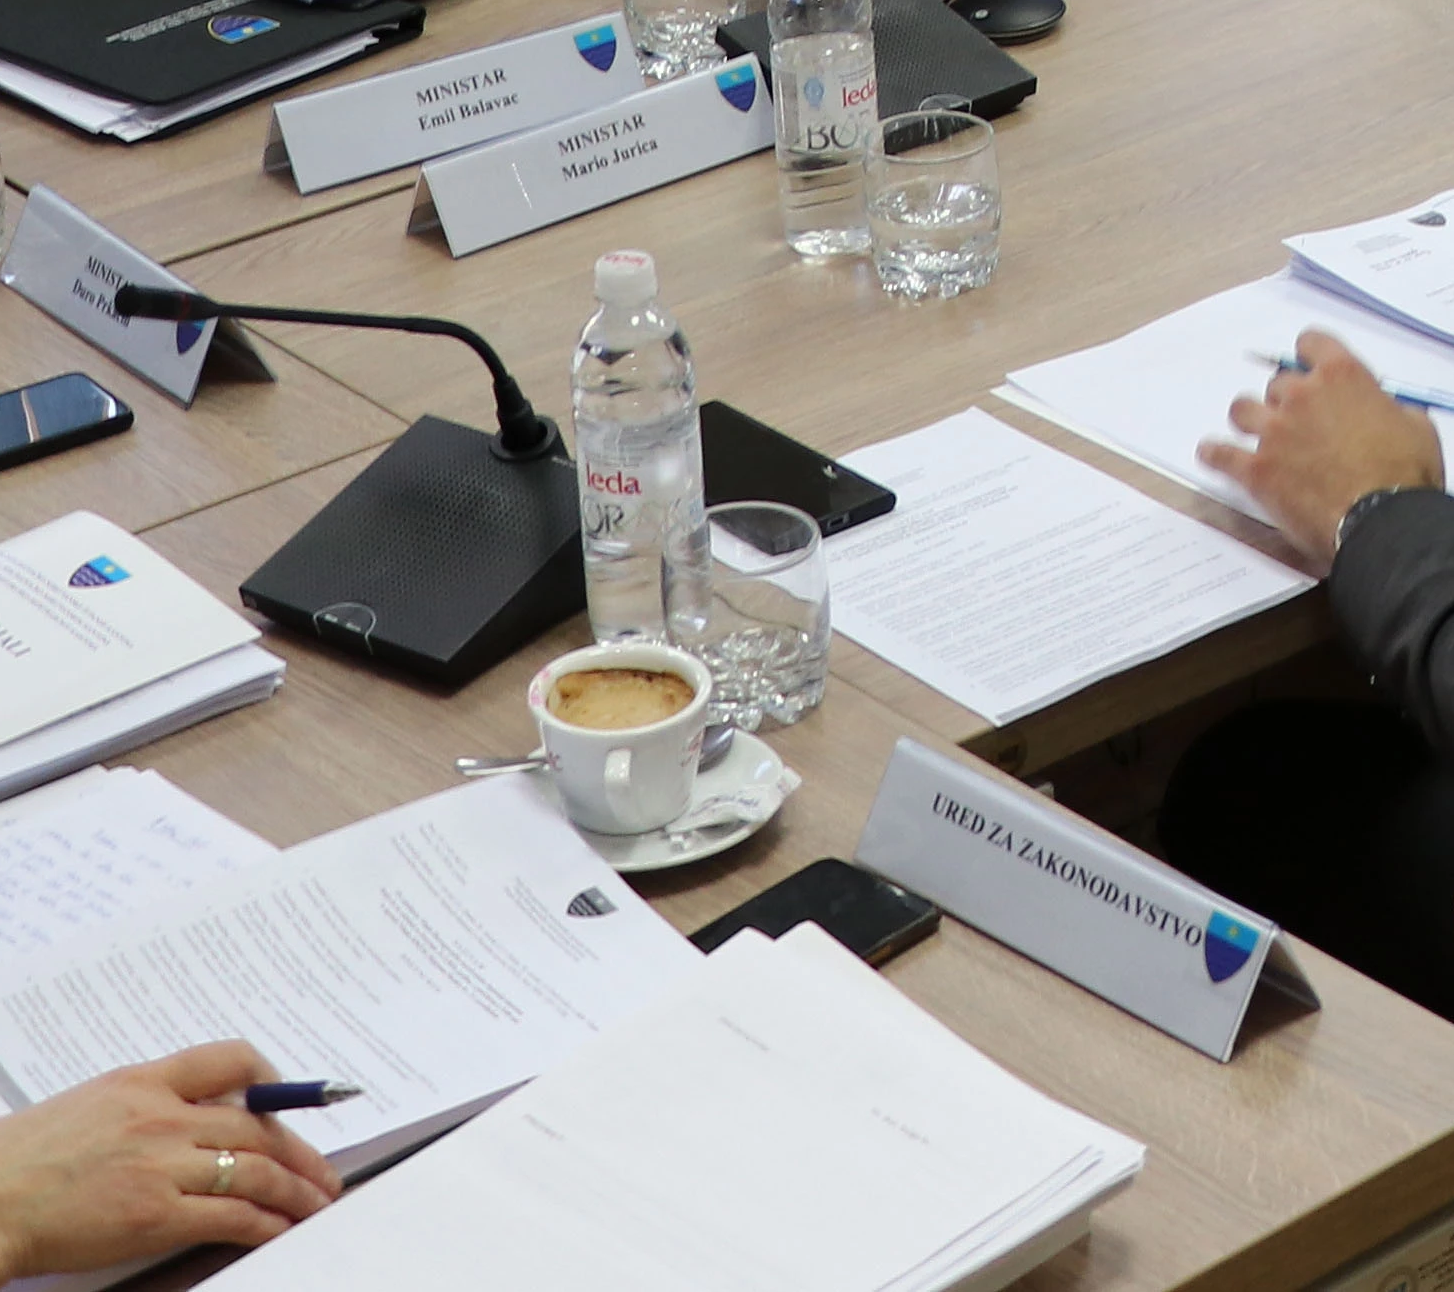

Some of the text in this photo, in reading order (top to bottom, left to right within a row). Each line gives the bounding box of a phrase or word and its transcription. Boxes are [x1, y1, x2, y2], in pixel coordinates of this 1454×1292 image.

[416, 67, 508, 106] MINISTAR
[841, 81, 876, 108] leda
[418, 92, 520, 131] Emil Balavac
[558, 114, 647, 155] MINISTAR
[562, 139, 659, 182] Mario Jurica
[86, 255, 129, 290] MINIST
[586, 460, 642, 495] leda
[932, 792, 1203, 947] URED ZA ZAKONODAVSTVO
